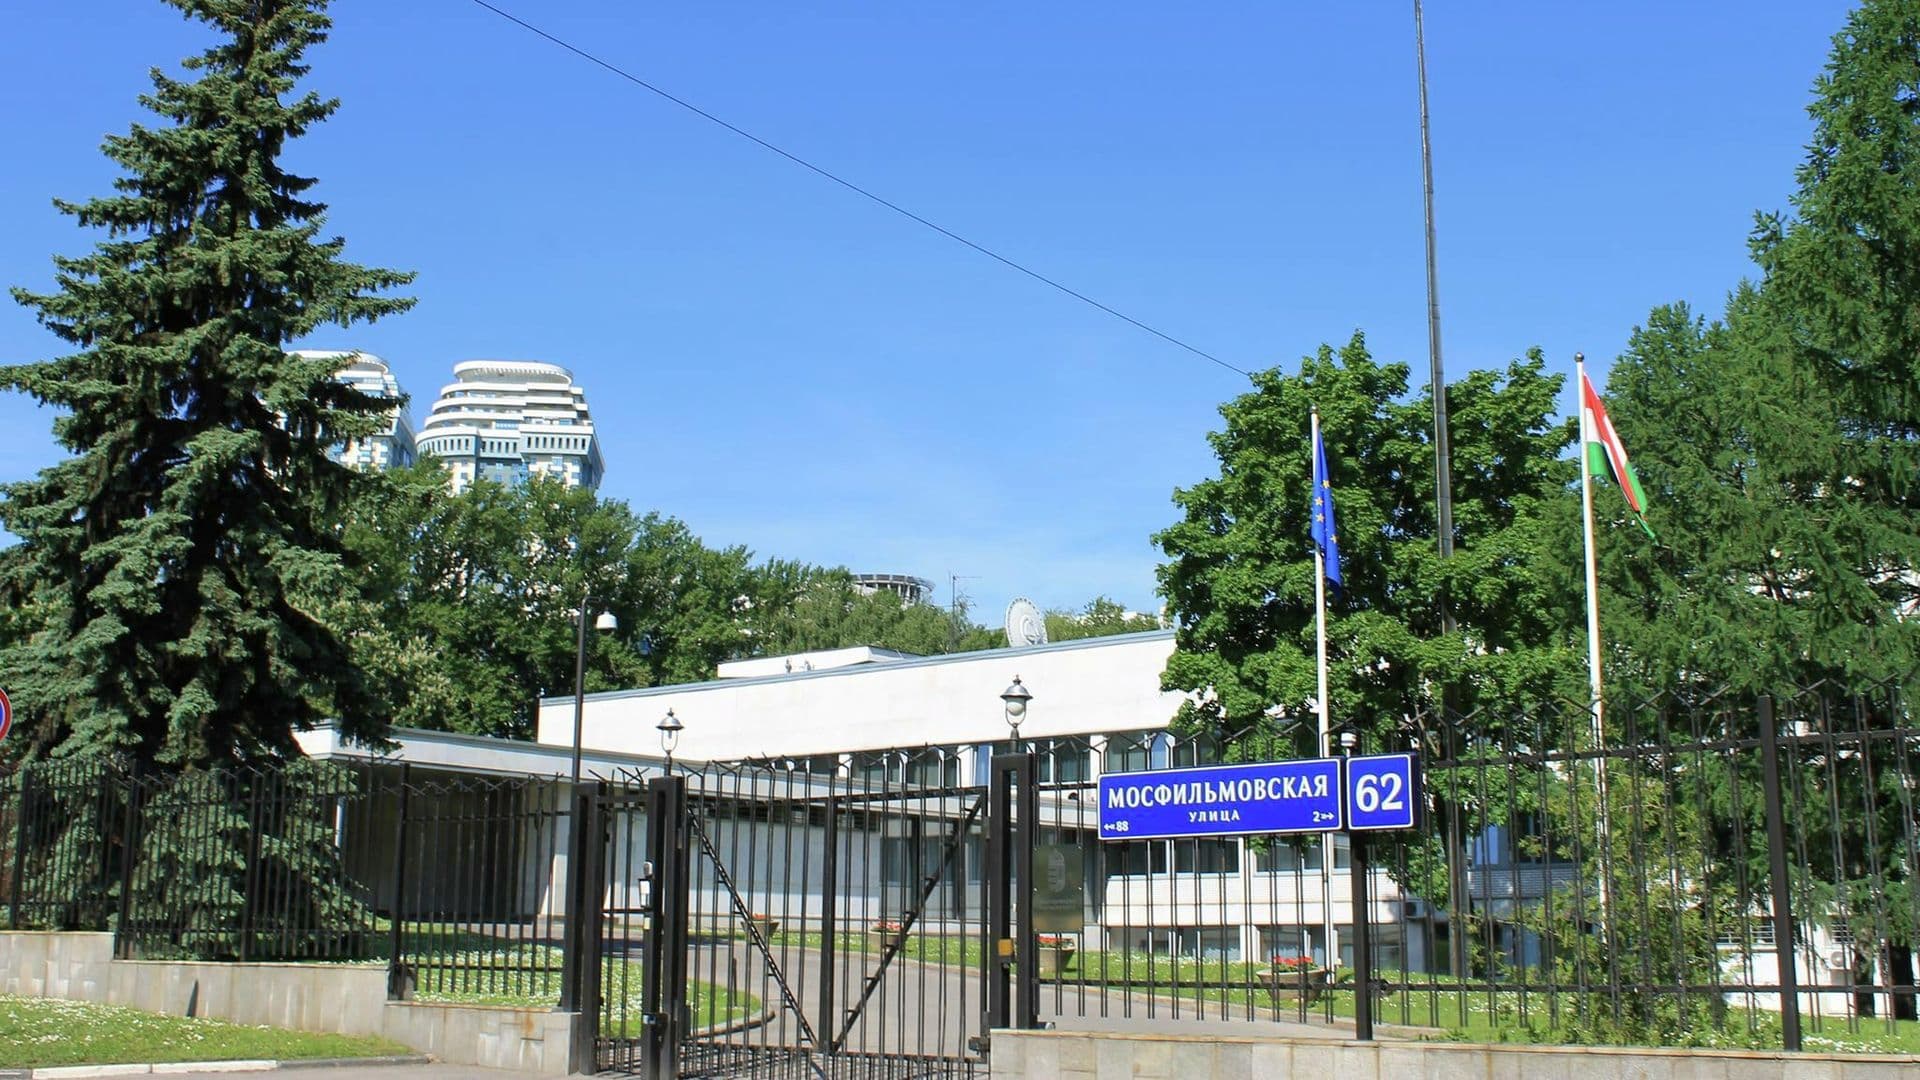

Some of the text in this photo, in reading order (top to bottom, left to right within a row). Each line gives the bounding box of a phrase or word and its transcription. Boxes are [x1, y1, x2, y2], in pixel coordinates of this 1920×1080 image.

[1108, 774, 1328, 808] МОСФИЛЬМОВСКАЯ
[1355, 772, 1403, 812] 62
[1189, 810, 1240, 823] УЛИЦА
[1313, 811, 1321, 822] 2
[1116, 821, 1129, 832] 88
